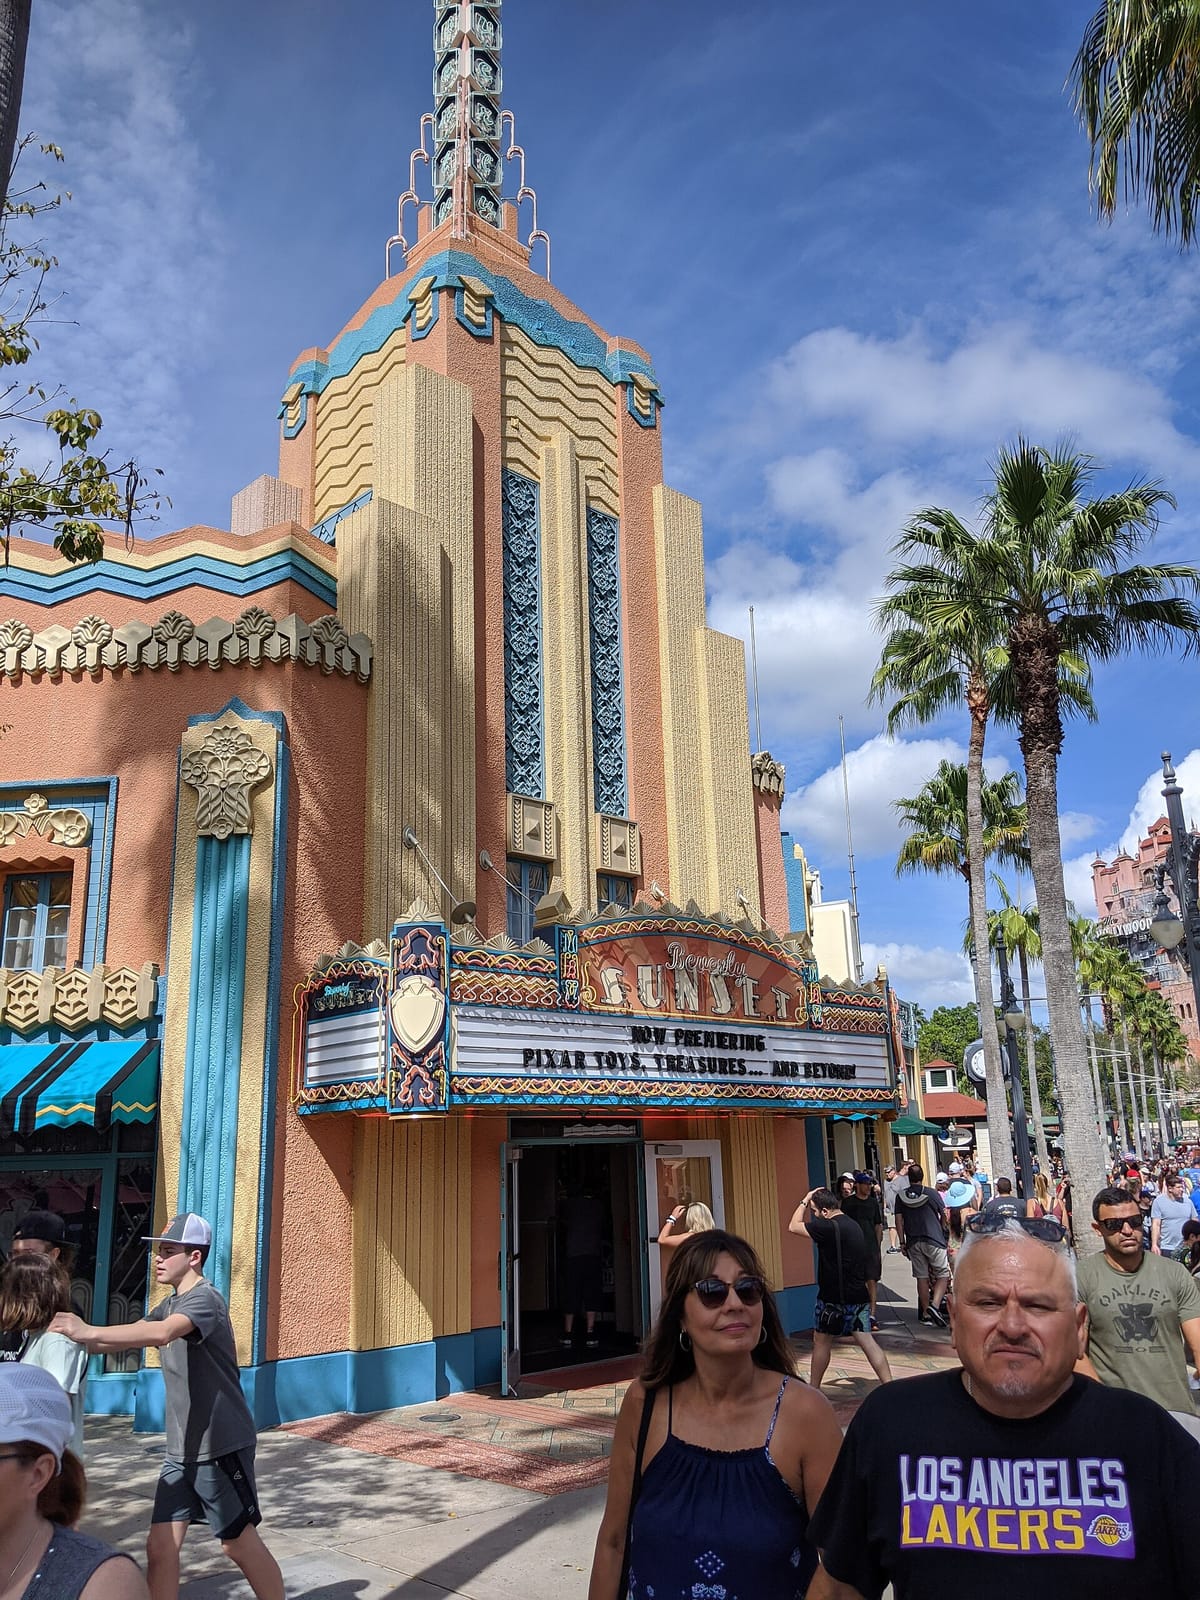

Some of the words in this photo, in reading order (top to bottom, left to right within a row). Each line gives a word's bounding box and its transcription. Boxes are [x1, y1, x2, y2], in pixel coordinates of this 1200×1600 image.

[665, 941, 748, 988] Beverly
[600, 964, 793, 1020] SUNSET
[631, 1025, 667, 1045] NOW
[522, 1048, 587, 1070] PIXAR
[593, 1050, 647, 1073] TOYS,
[653, 1053, 764, 1076] TREASURES...
[772, 1060, 800, 1078] AND
[803, 1061, 857, 1081] BEYOND!
[1099, 1284, 1171, 1307] OAKLEY
[900, 1455, 961, 1502] LOS
[968, 1459, 1128, 1509] ANGELES
[901, 1504, 1085, 1551] LAKERS
[1088, 1518, 1131, 1541] LAKERS
